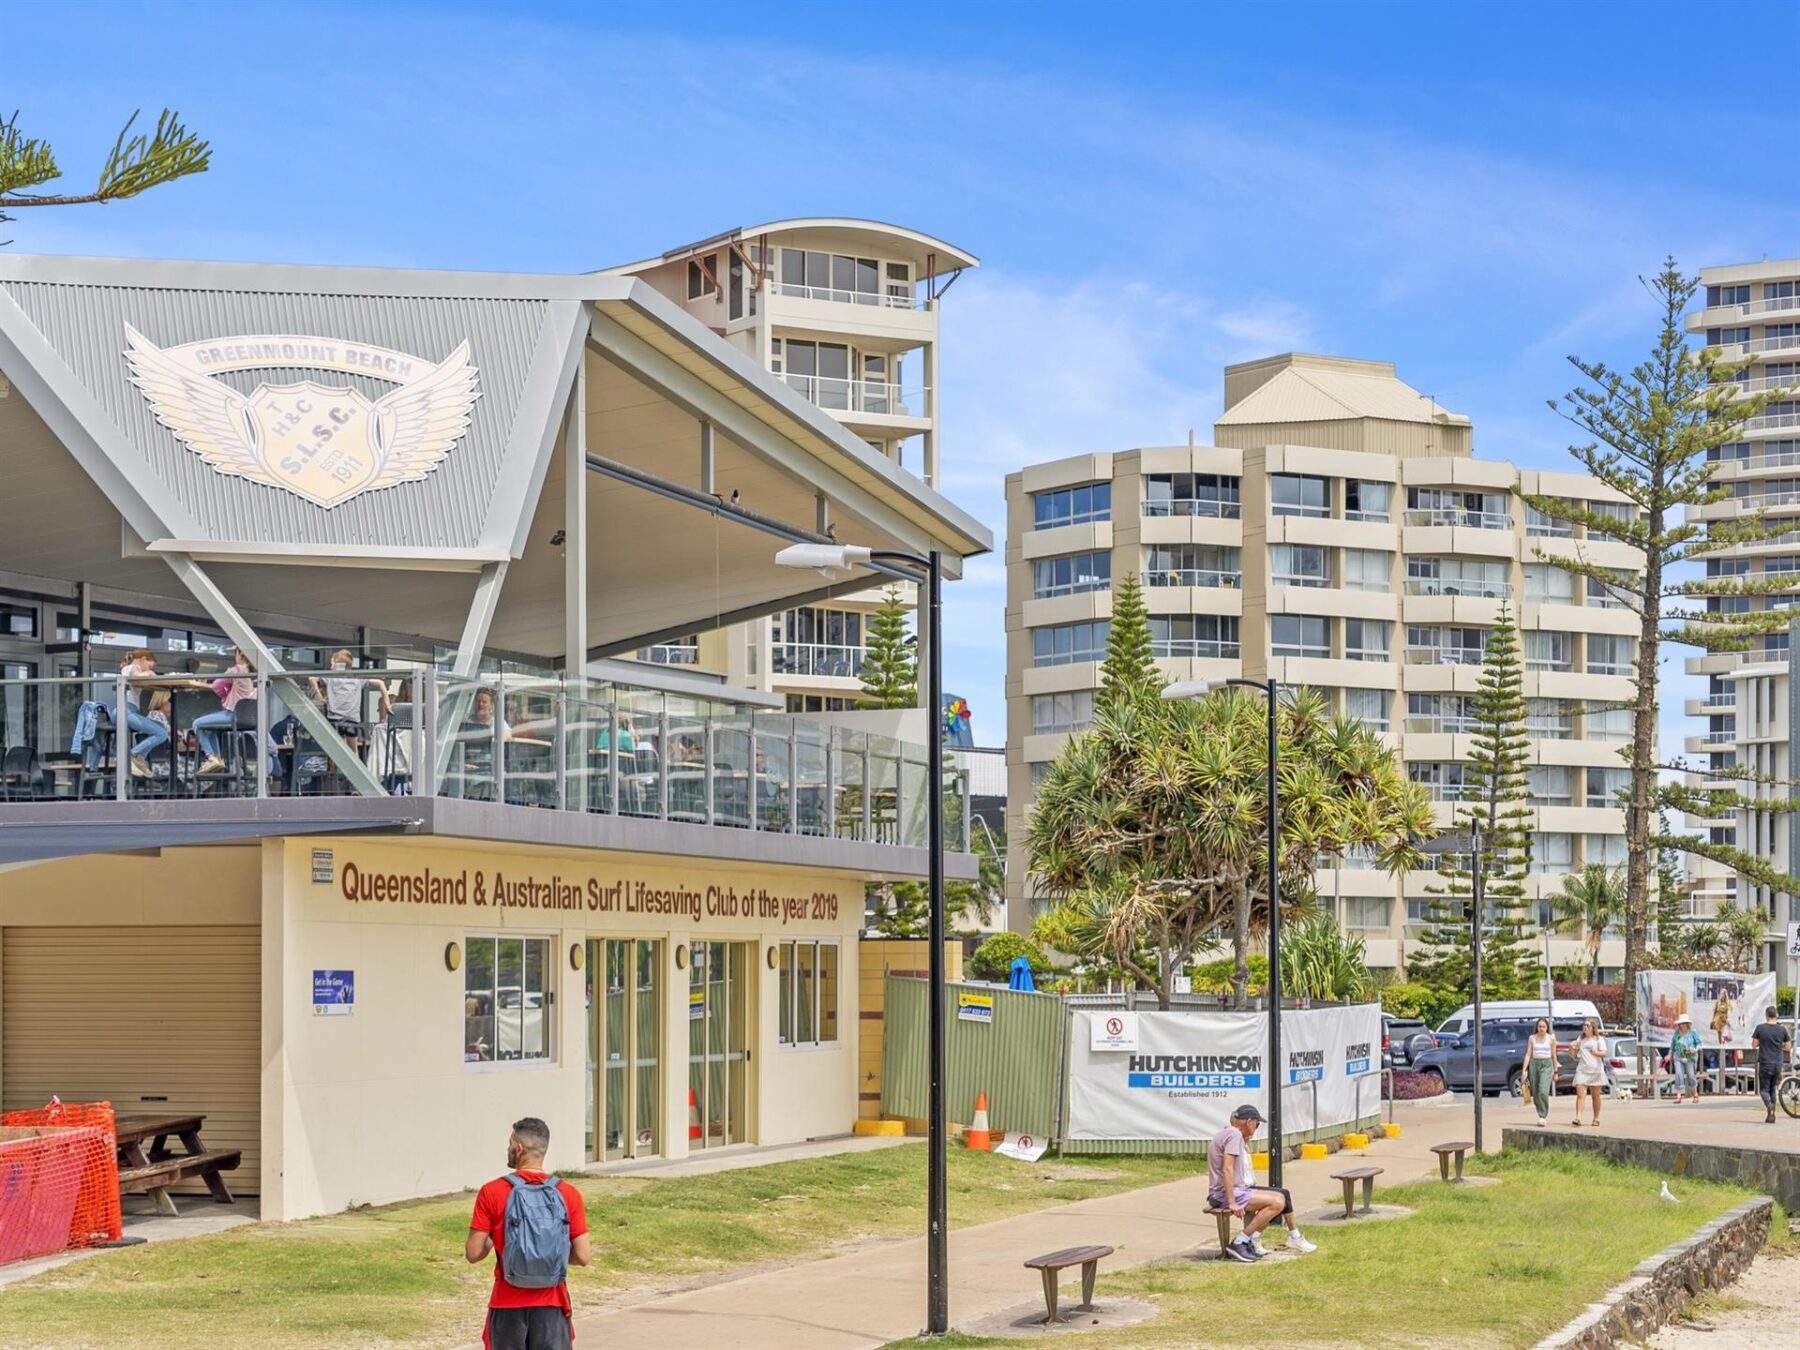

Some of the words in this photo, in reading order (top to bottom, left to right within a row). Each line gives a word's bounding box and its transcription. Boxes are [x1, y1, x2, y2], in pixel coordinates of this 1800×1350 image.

[195, 343, 337, 365] GREENMOUNT
[345, 350, 412, 376] BEACH
[331, 455, 364, 484] 1911
[341, 862, 467, 906] Queensland
[473, 871, 487, 906] &
[492, 872, 582, 911] Australian
[587, 878, 622, 912] Surf
[625, 880, 701, 923] Lifesaving
[706, 885, 737, 917] Club
[741, 889, 756, 917] of
[758, 890, 779, 918] the
[782, 900, 809, 925] year
[811, 893, 838, 921] 2019
[1129, 1055, 1262, 1073] HUTCHINSON
[1150, 1075, 1246, 1087] BUILDERS
[1168, 1090, 1210, 1098] Established
